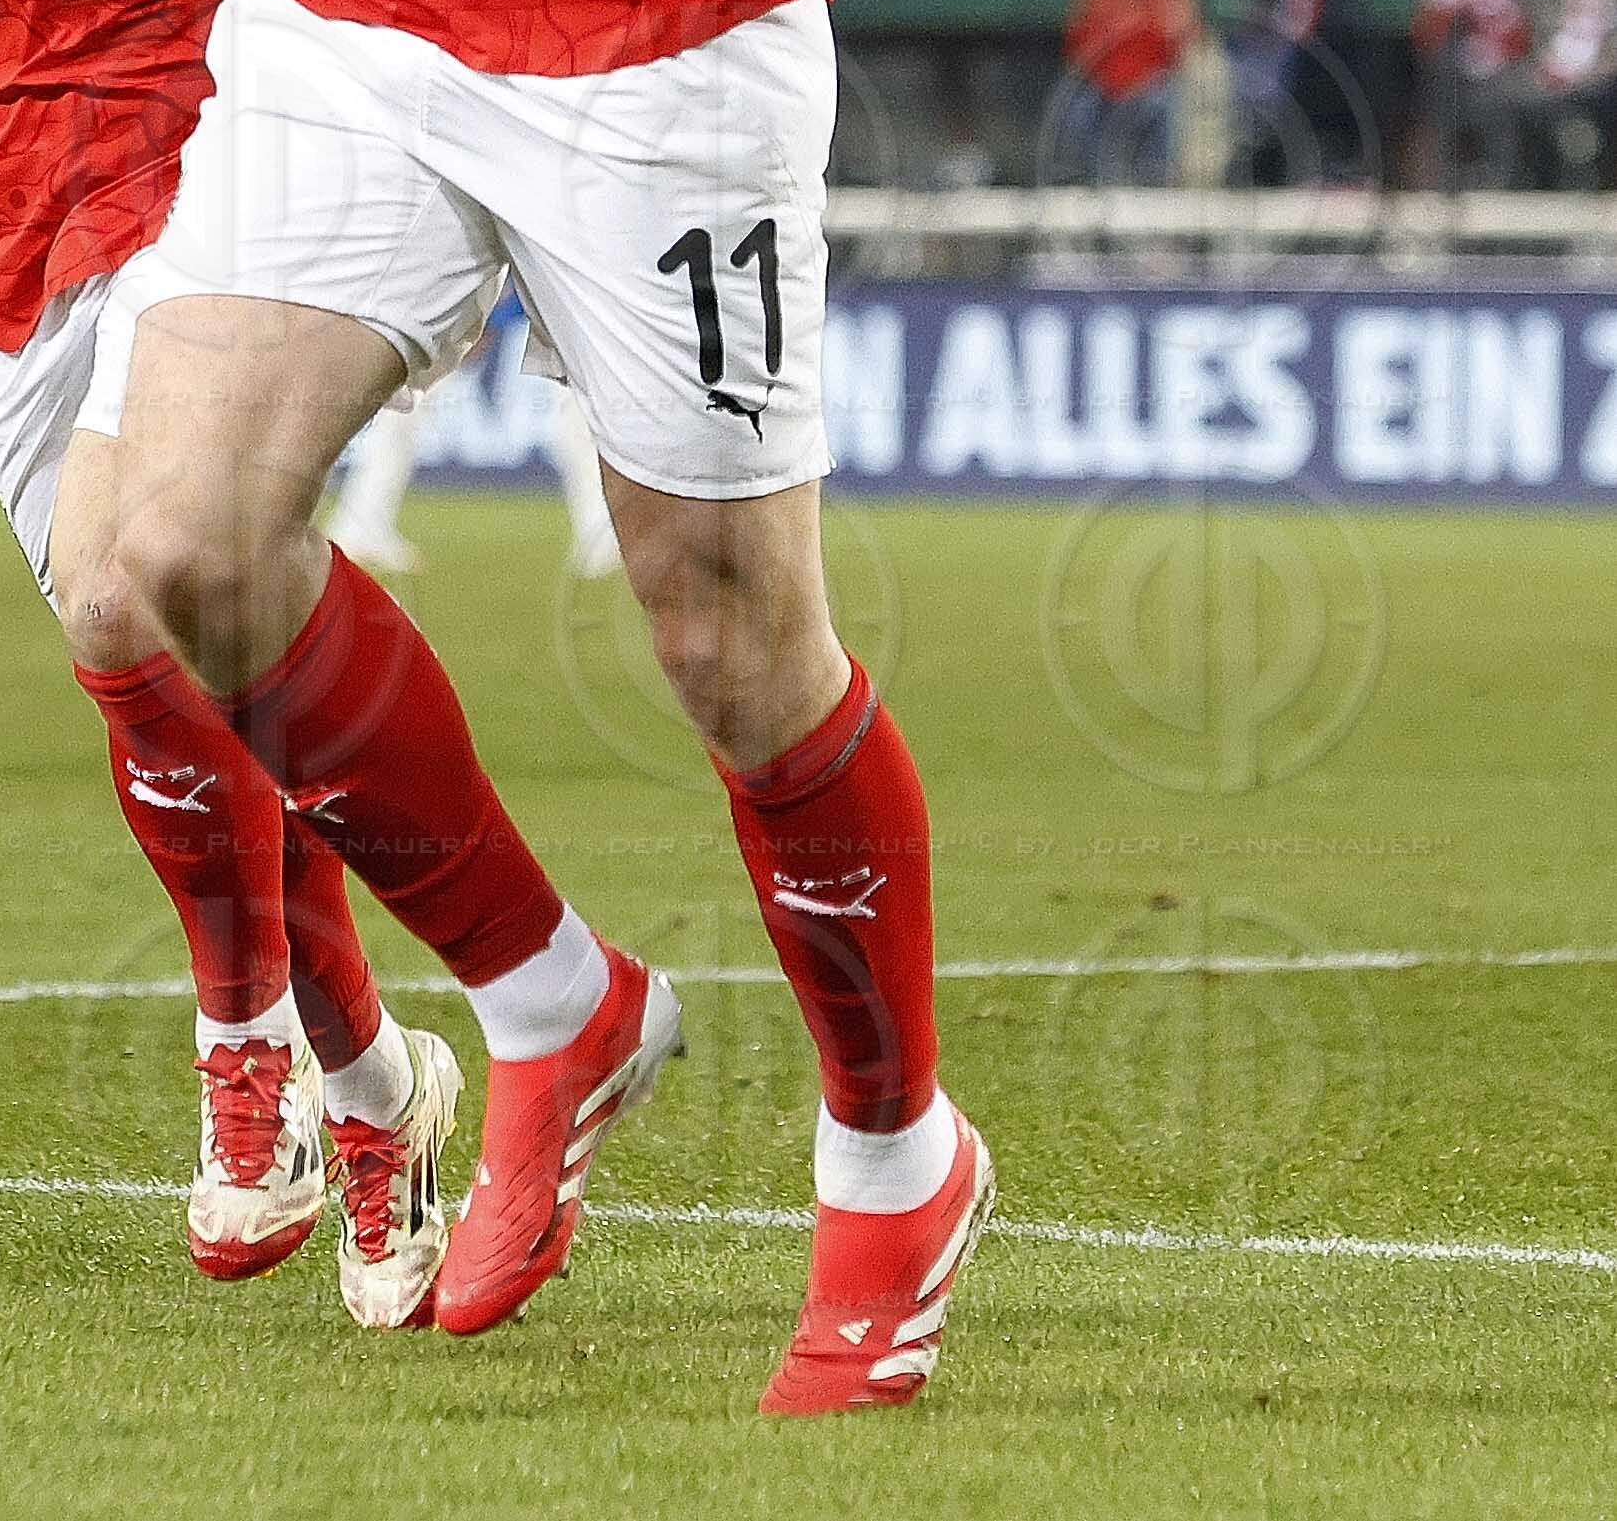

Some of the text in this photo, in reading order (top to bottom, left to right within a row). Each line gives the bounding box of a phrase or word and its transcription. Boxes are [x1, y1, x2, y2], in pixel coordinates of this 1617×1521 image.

[657, 218, 784, 386] 11
[921, 304, 1317, 483] ALLES
[1334, 304, 1565, 486] EIN
